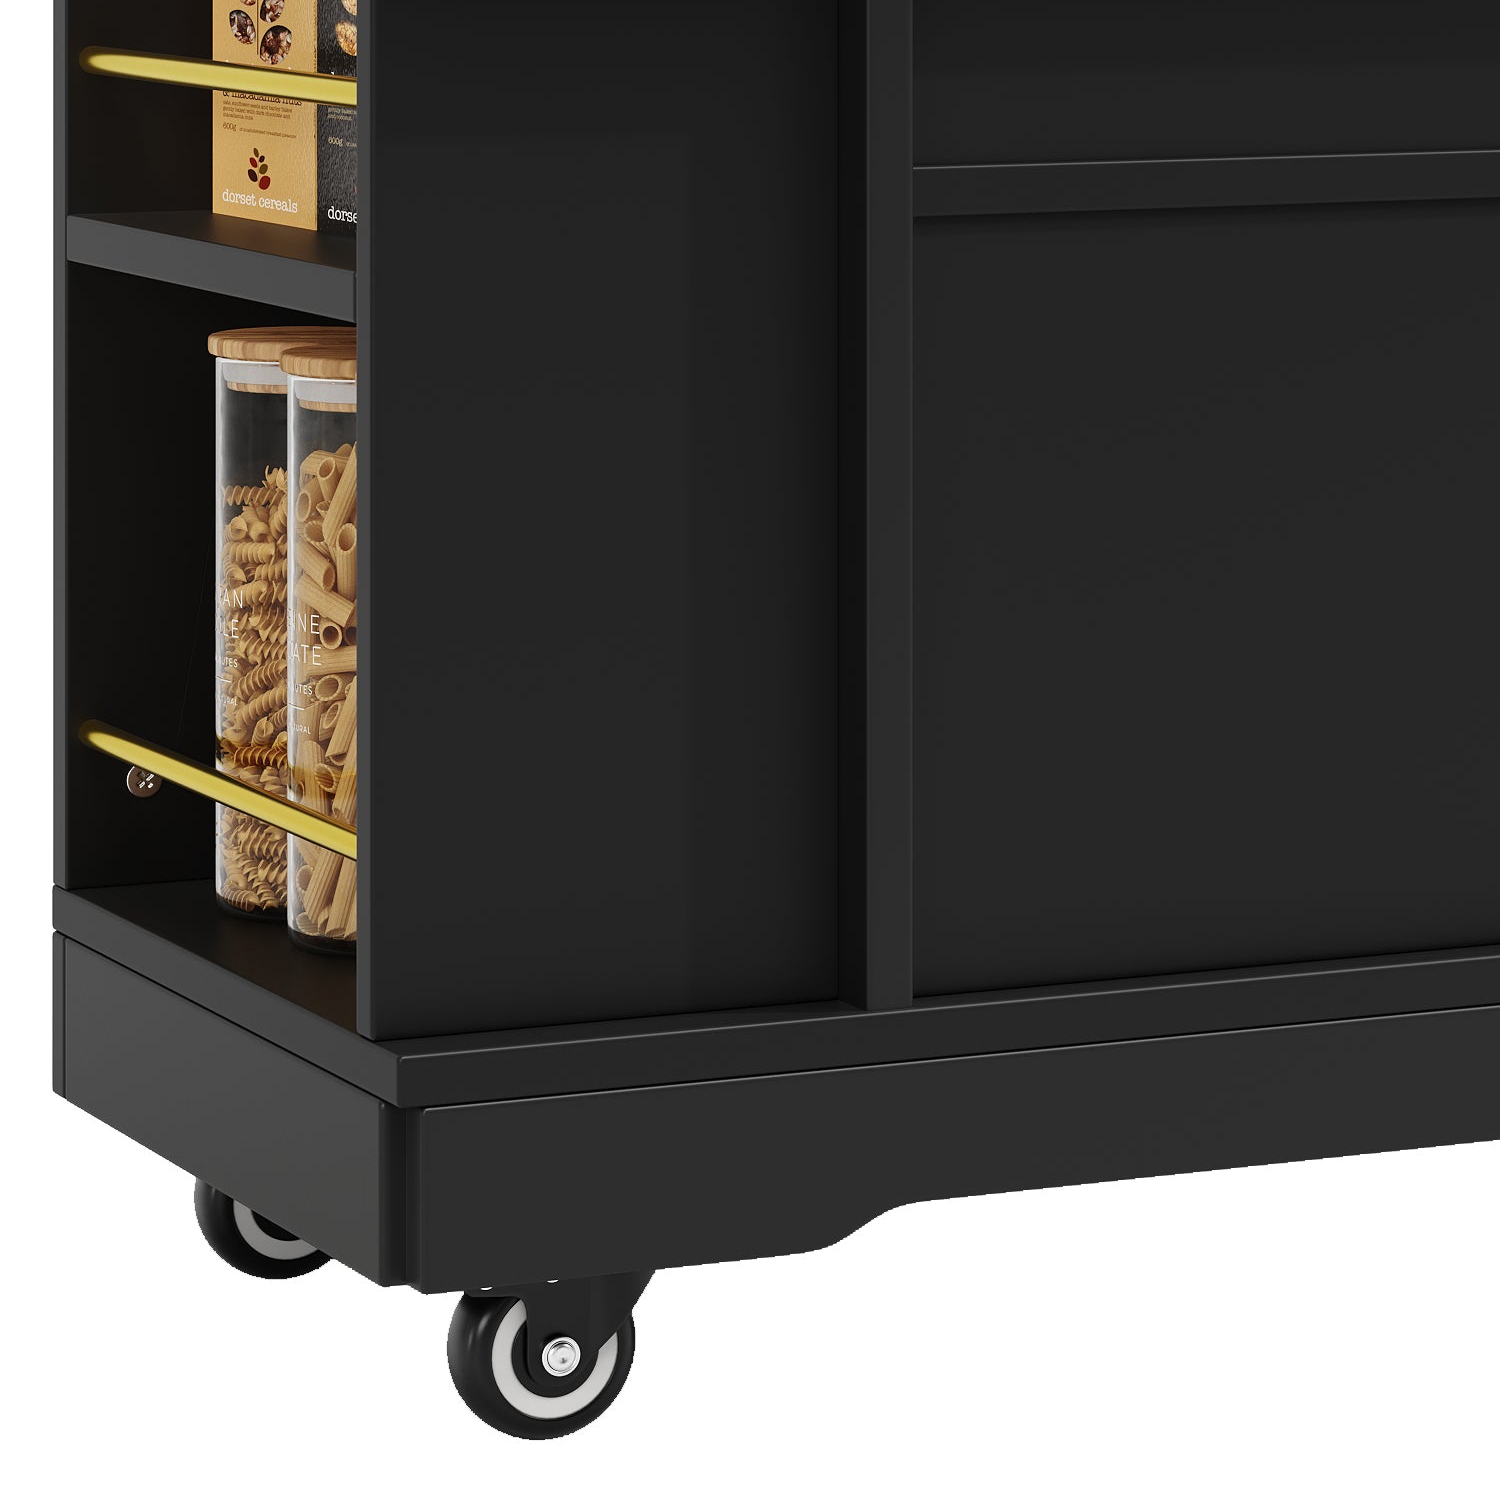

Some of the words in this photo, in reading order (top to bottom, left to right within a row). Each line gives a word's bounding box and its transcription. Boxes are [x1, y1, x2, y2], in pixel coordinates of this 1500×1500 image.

[222, 122, 237, 132] 600g
[328, 136, 343, 147] 600g
[222, 189, 256, 207] dorset
[258, 197, 298, 213] cereals
[327, 206, 357, 223] dorse
